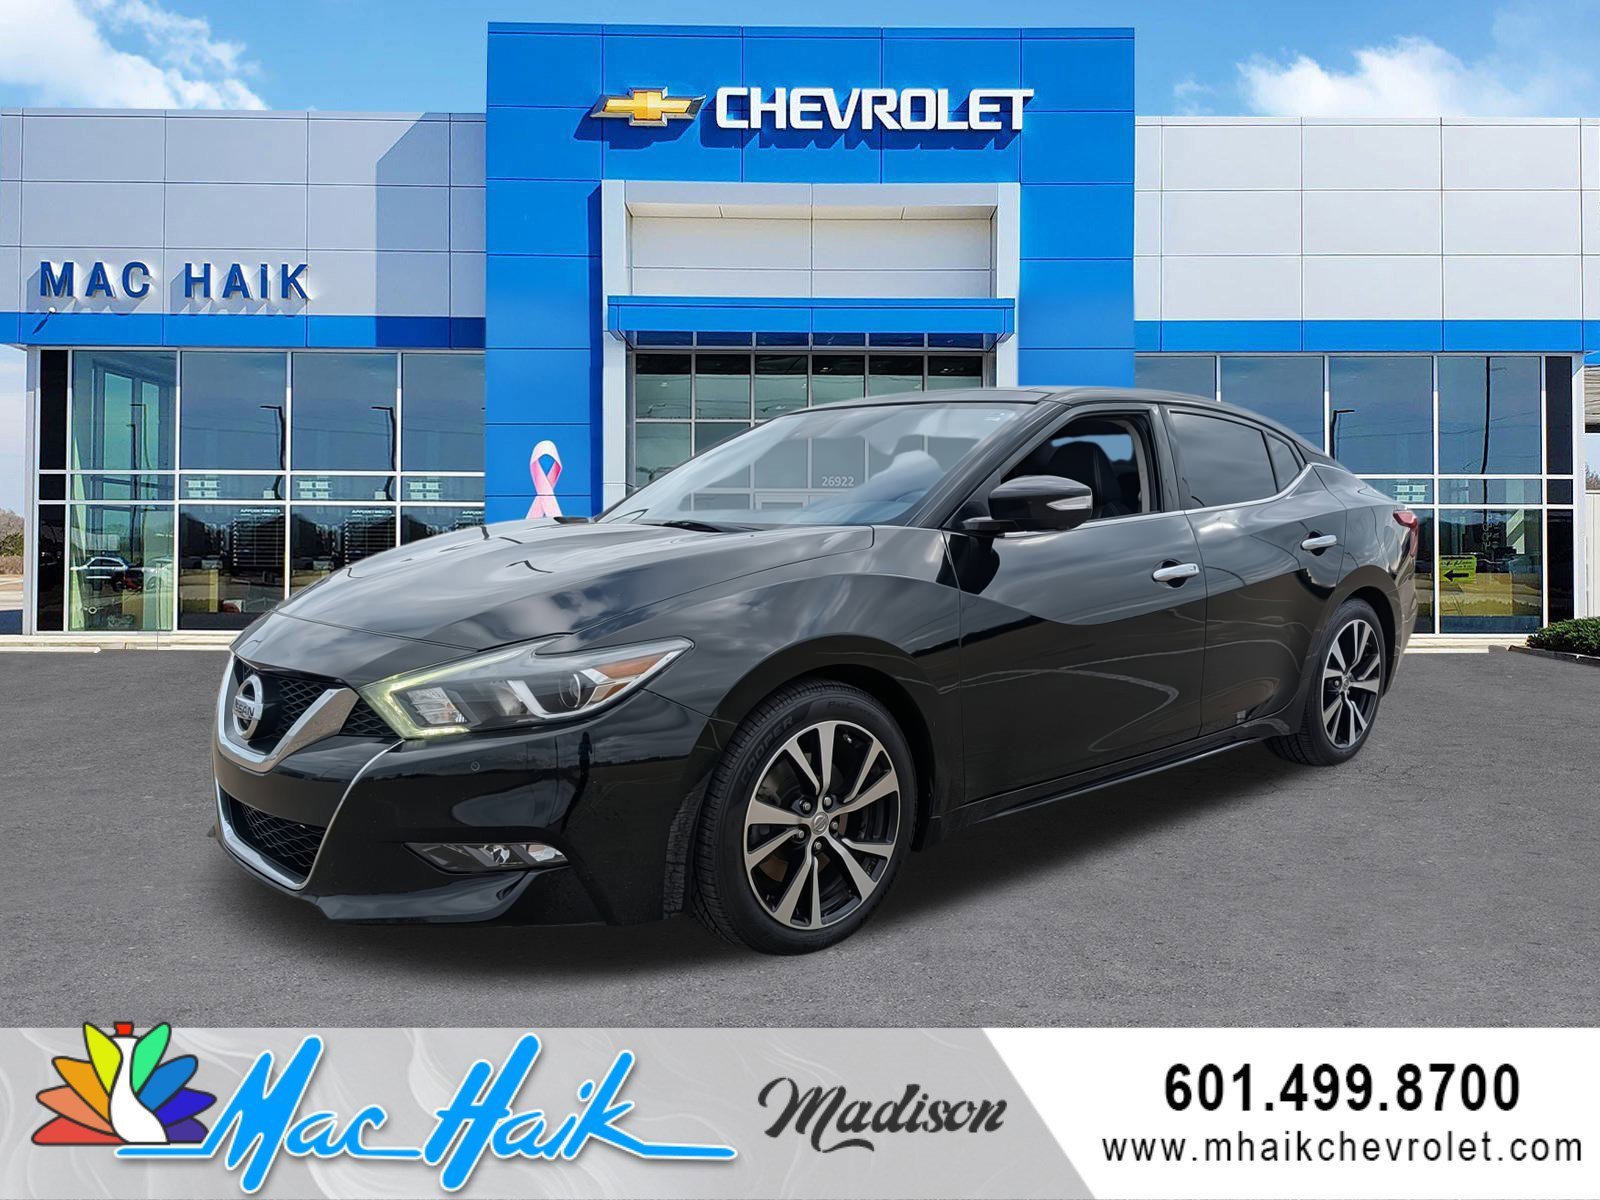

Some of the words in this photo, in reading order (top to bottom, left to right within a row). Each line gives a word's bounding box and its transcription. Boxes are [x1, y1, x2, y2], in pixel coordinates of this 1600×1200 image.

[716, 87, 1035, 130] CHEVROLET
[40, 261, 150, 299] MAC
[184, 262, 309, 300] HAIK
[821, 475, 855, 487] 26922
